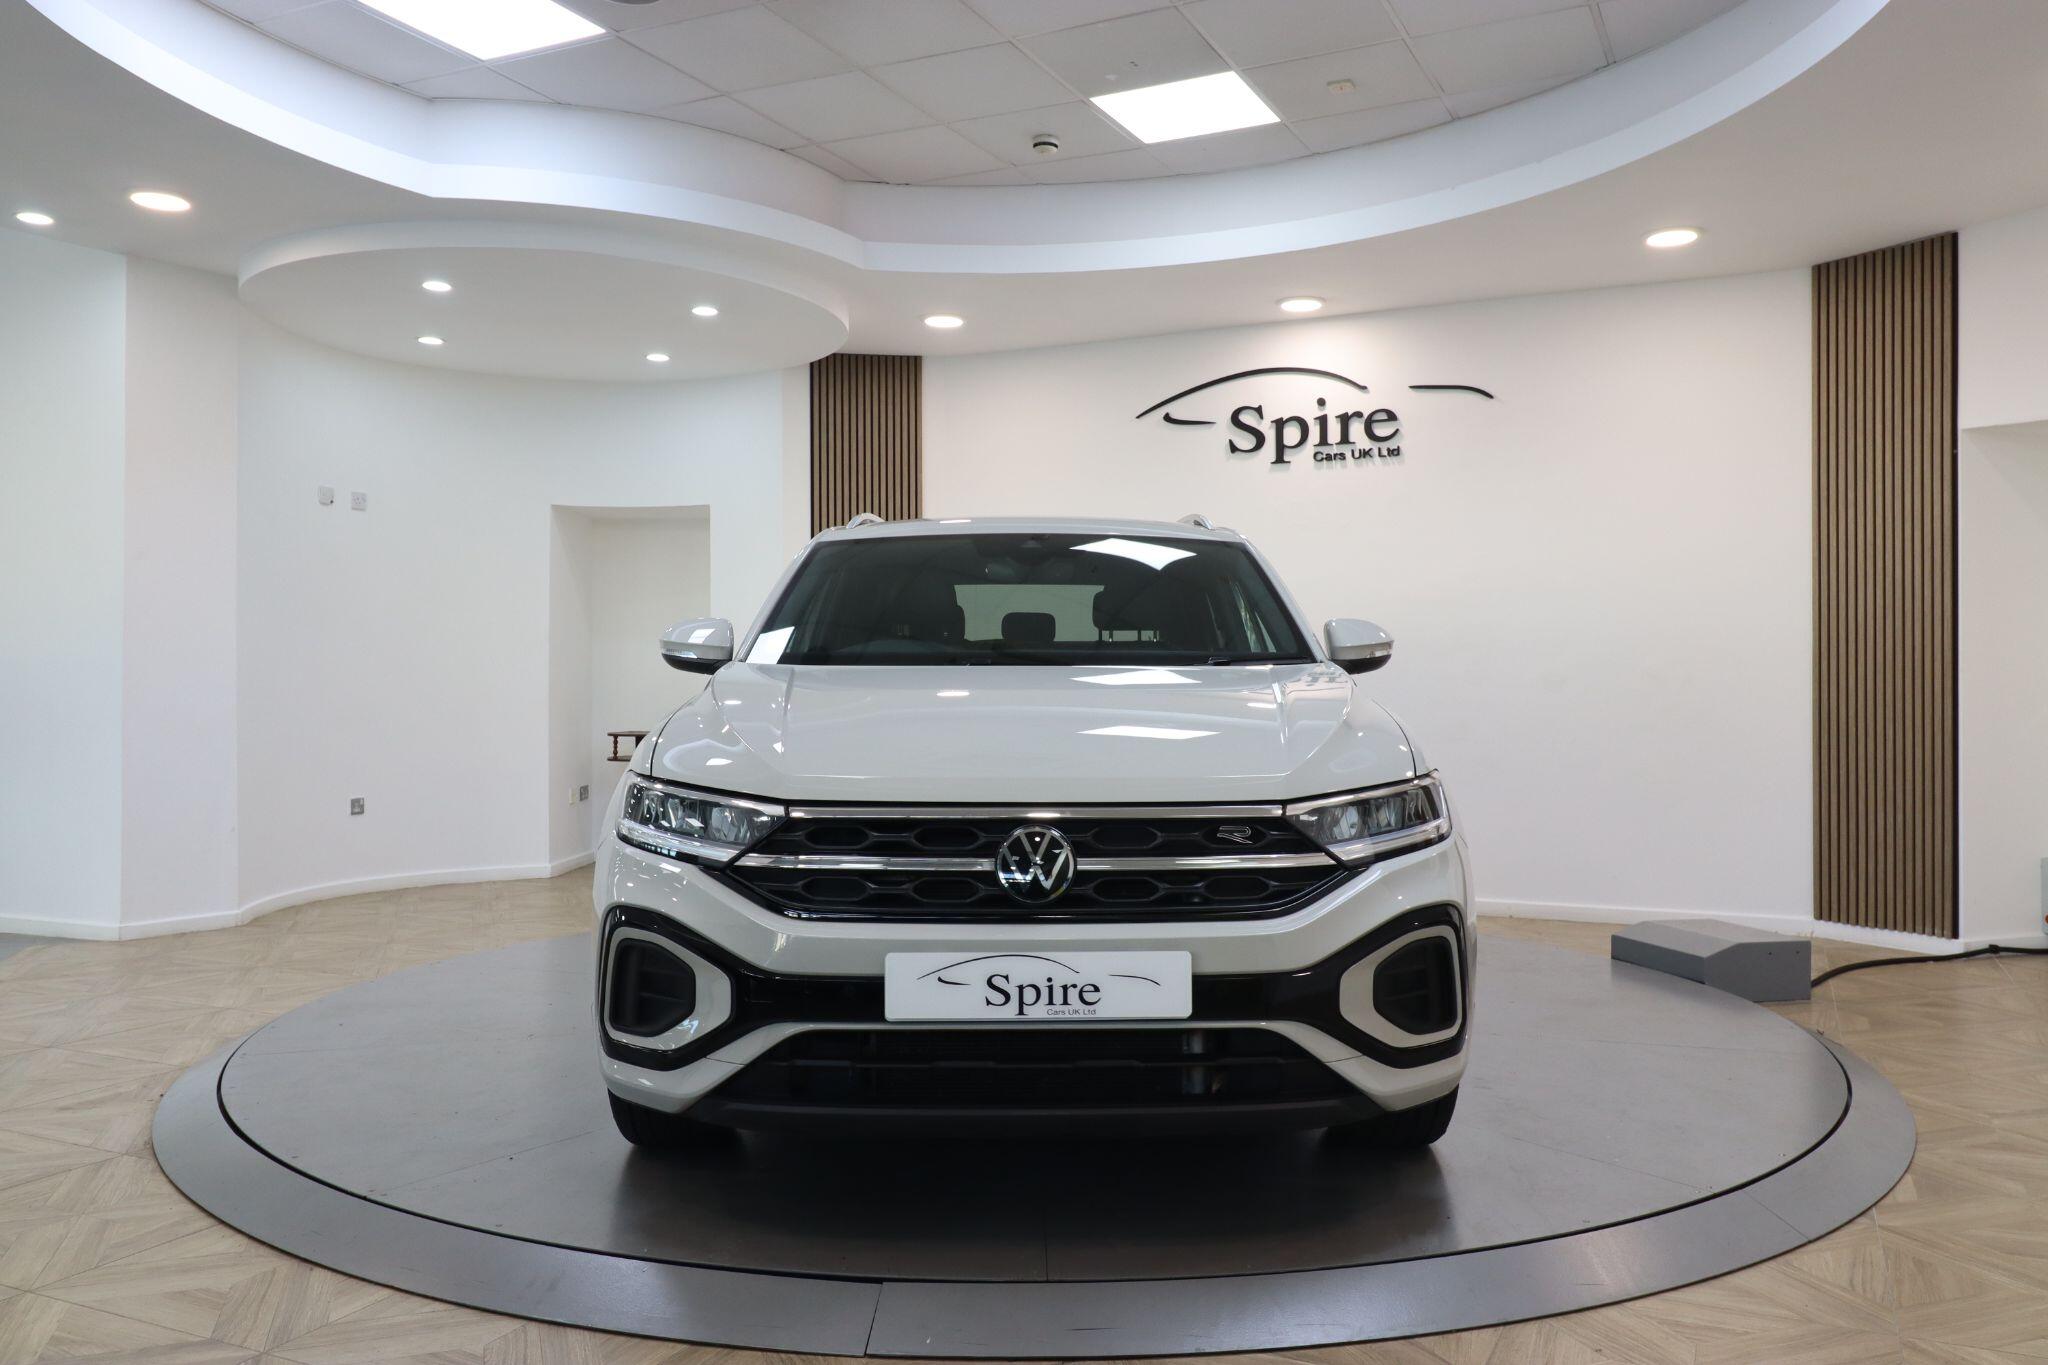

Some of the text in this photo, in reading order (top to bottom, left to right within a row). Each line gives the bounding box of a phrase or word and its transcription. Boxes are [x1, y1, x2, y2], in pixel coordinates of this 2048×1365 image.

[1228, 397, 1399, 464] Spire
[1313, 445, 1400, 462] Cars UK Ltd
[985, 973, 1101, 1016] Spire
[1046, 1008, 1097, 1016] Cars UK Ltd
